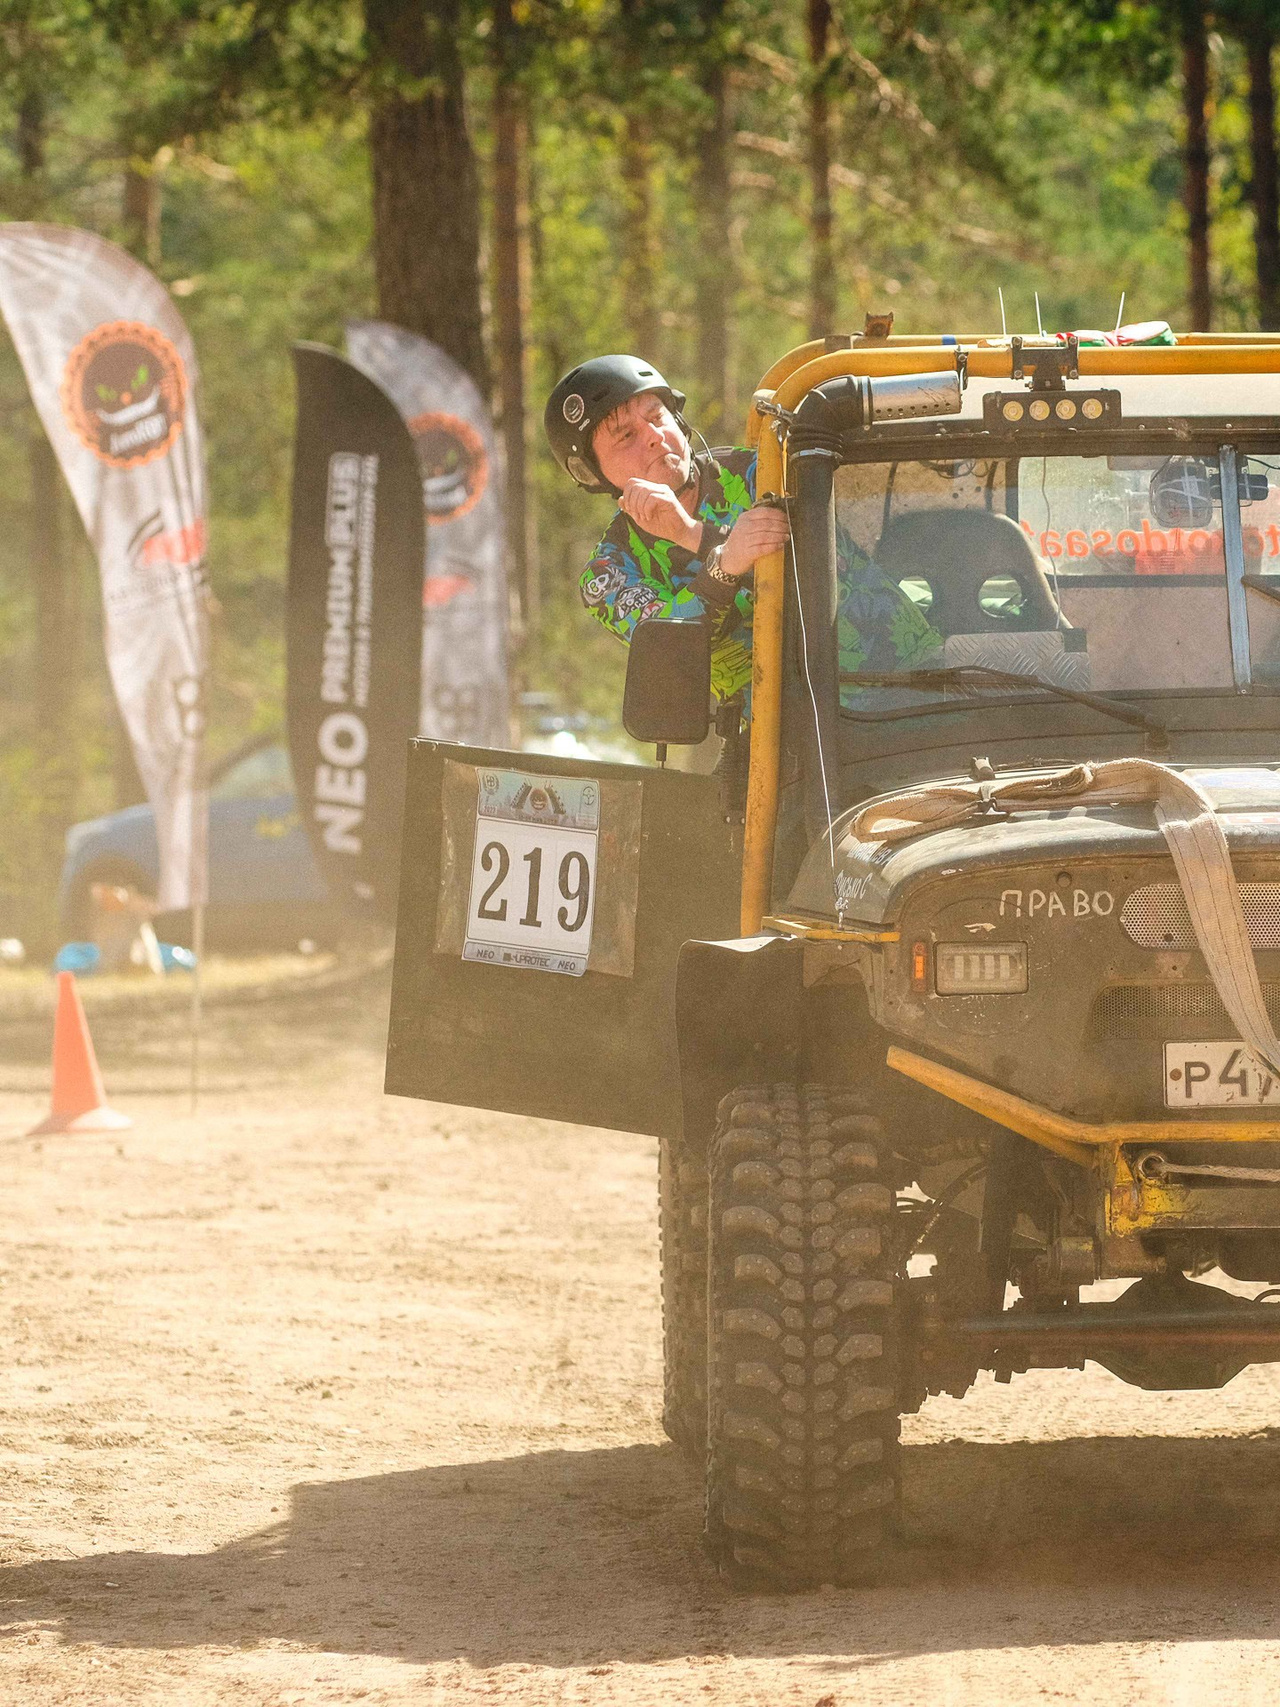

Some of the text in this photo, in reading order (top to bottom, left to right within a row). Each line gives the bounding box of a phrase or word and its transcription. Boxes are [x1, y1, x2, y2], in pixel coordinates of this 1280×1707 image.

[316, 455, 369, 855] NEO PREMIUM PLUS
[477, 841, 590, 932] 219
[999, 889, 1114, 917] ПРАВО
[476, 949, 495, 959] NEO
[557, 960, 576, 971] NEO
